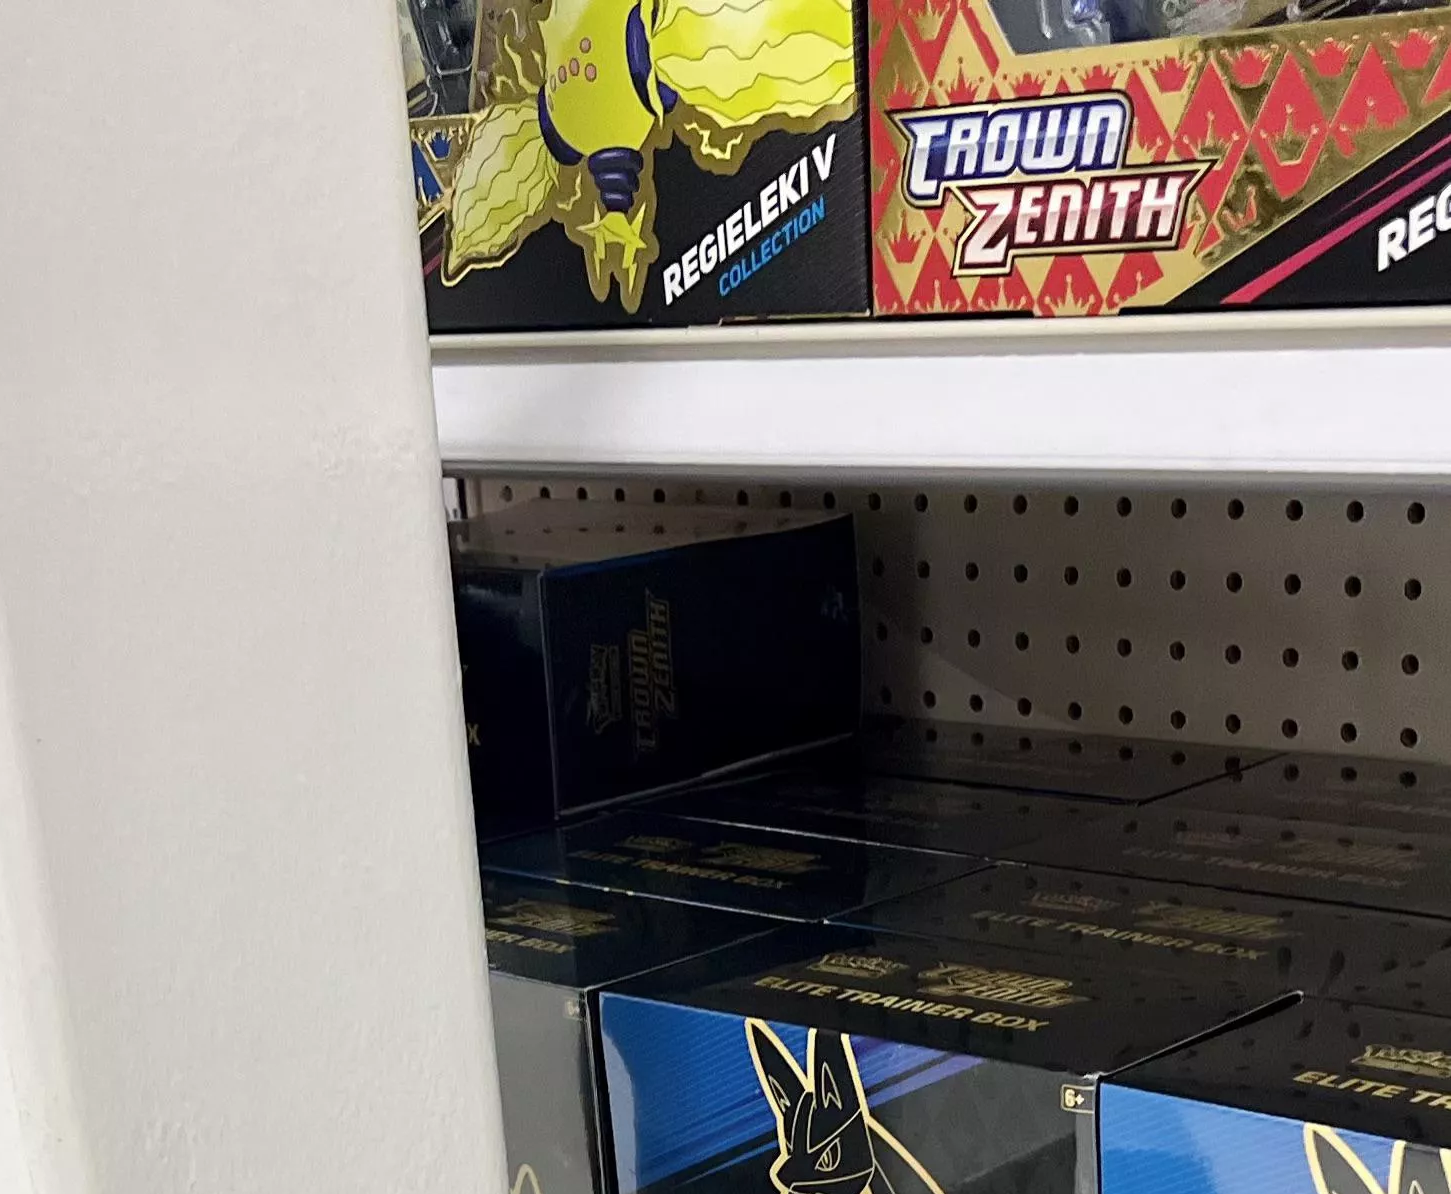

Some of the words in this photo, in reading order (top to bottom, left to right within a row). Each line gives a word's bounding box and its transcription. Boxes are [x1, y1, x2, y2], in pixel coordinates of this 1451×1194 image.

[904, 101, 1126, 197] CROWN
[662, 156, 810, 306] REGIELEKI
[811, 132, 837, 182] V
[717, 194, 826, 297] COLLECTION
[962, 175, 1190, 265] ZENITH
[754, 975, 839, 998] ELITE
[836, 988, 975, 1021] TRAINER
[971, 1012, 1050, 1032] BOX
[1064, 1088, 1085, 1108] 6+
[1292, 1070, 1410, 1099] ELITE
